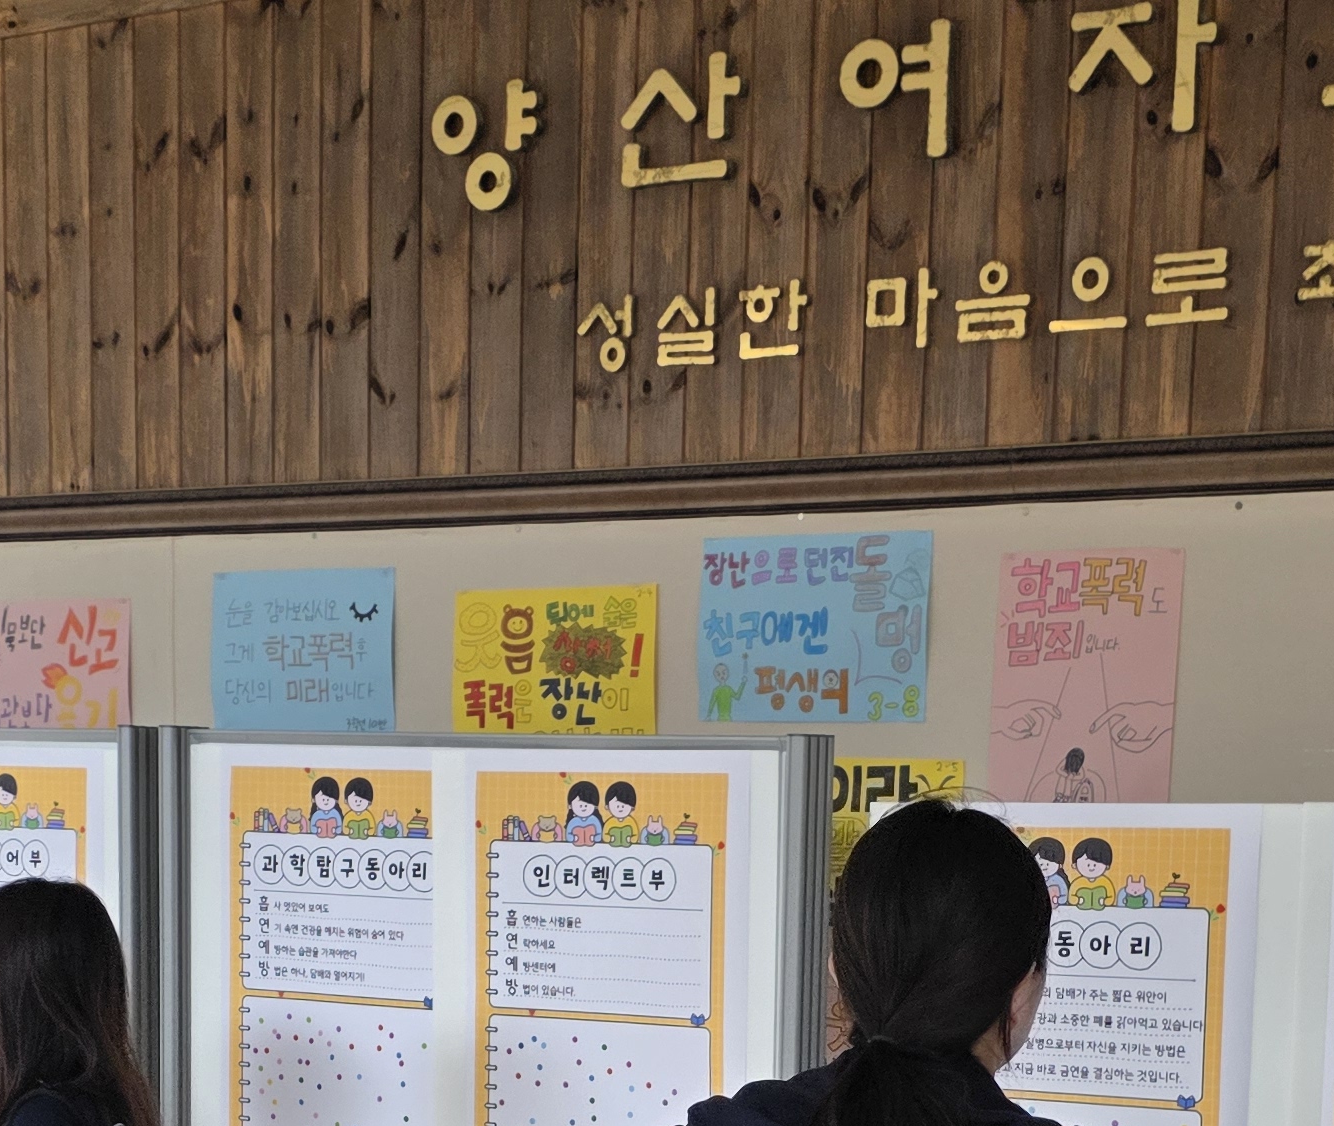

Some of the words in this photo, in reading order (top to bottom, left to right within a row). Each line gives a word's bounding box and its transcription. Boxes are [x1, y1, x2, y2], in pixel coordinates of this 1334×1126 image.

[576, 277, 808, 373] 성실한
[867, 247, 1229, 349] 마음으로
[704, 546, 797, 588] 장난으로
[805, 545, 853, 585] 던진
[850, 534, 891, 614] 돌
[226, 598, 253, 628] 눈을
[264, 598, 340, 623] 감아보십시오
[57, 605, 119, 675] 신고
[454, 602, 535, 675] 웃음
[704, 607, 828, 657] 친구에겐
[876, 605, 922, 673] 멍
[224, 642, 254, 663] 그게
[225, 678, 271, 705] 당신의
[868, 685, 920, 721] 3-8
[463, 679, 532, 730] 폭력은
[539, 677, 629, 726] 장난이
[261, 853, 427, 881] 과학탐구동아리
[533, 865, 665, 891] 인터렉트부
[259, 896, 269, 911] 흡
[259, 918, 269, 933] 연
[506, 909, 518, 926] 흡
[523, 915, 547, 926] 연하는
[549, 916, 582, 928] 사람들은
[258, 940, 269, 954] 예
[506, 933, 517, 949] 연
[523, 939, 555, 950] 락하세요
[1054, 931, 1150, 958] 동아리
[259, 961, 270, 976] 방
[505, 956, 518, 971] 예
[523, 962, 556, 973] 방센터에
[506, 979, 518, 996] 방
[523, 984, 538, 995] 법이
[1056, 987, 1086, 1000] 담배가
[1089, 989, 1108, 1002] 주는
[1112, 990, 1132, 1002] 짧은
[1135, 991, 1167, 1004] 위안이
[1034, 1012, 1057, 1024] 강과
[1060, 1013, 1090, 1027] 소중한
[1093, 1016, 1112, 1028] 폐를
[1117, 1016, 1158, 1029] 갉아먹고
[1087, 1042, 1117, 1054] 자신을
[1120, 1043, 1151, 1056] 지키는
[1155, 1045, 1186, 1057] 방법은
[1037, 1064, 1056, 1075] 바로
[1060, 1065, 1089, 1079] 금연을
[1093, 1067, 1134, 1080] 결심하는
